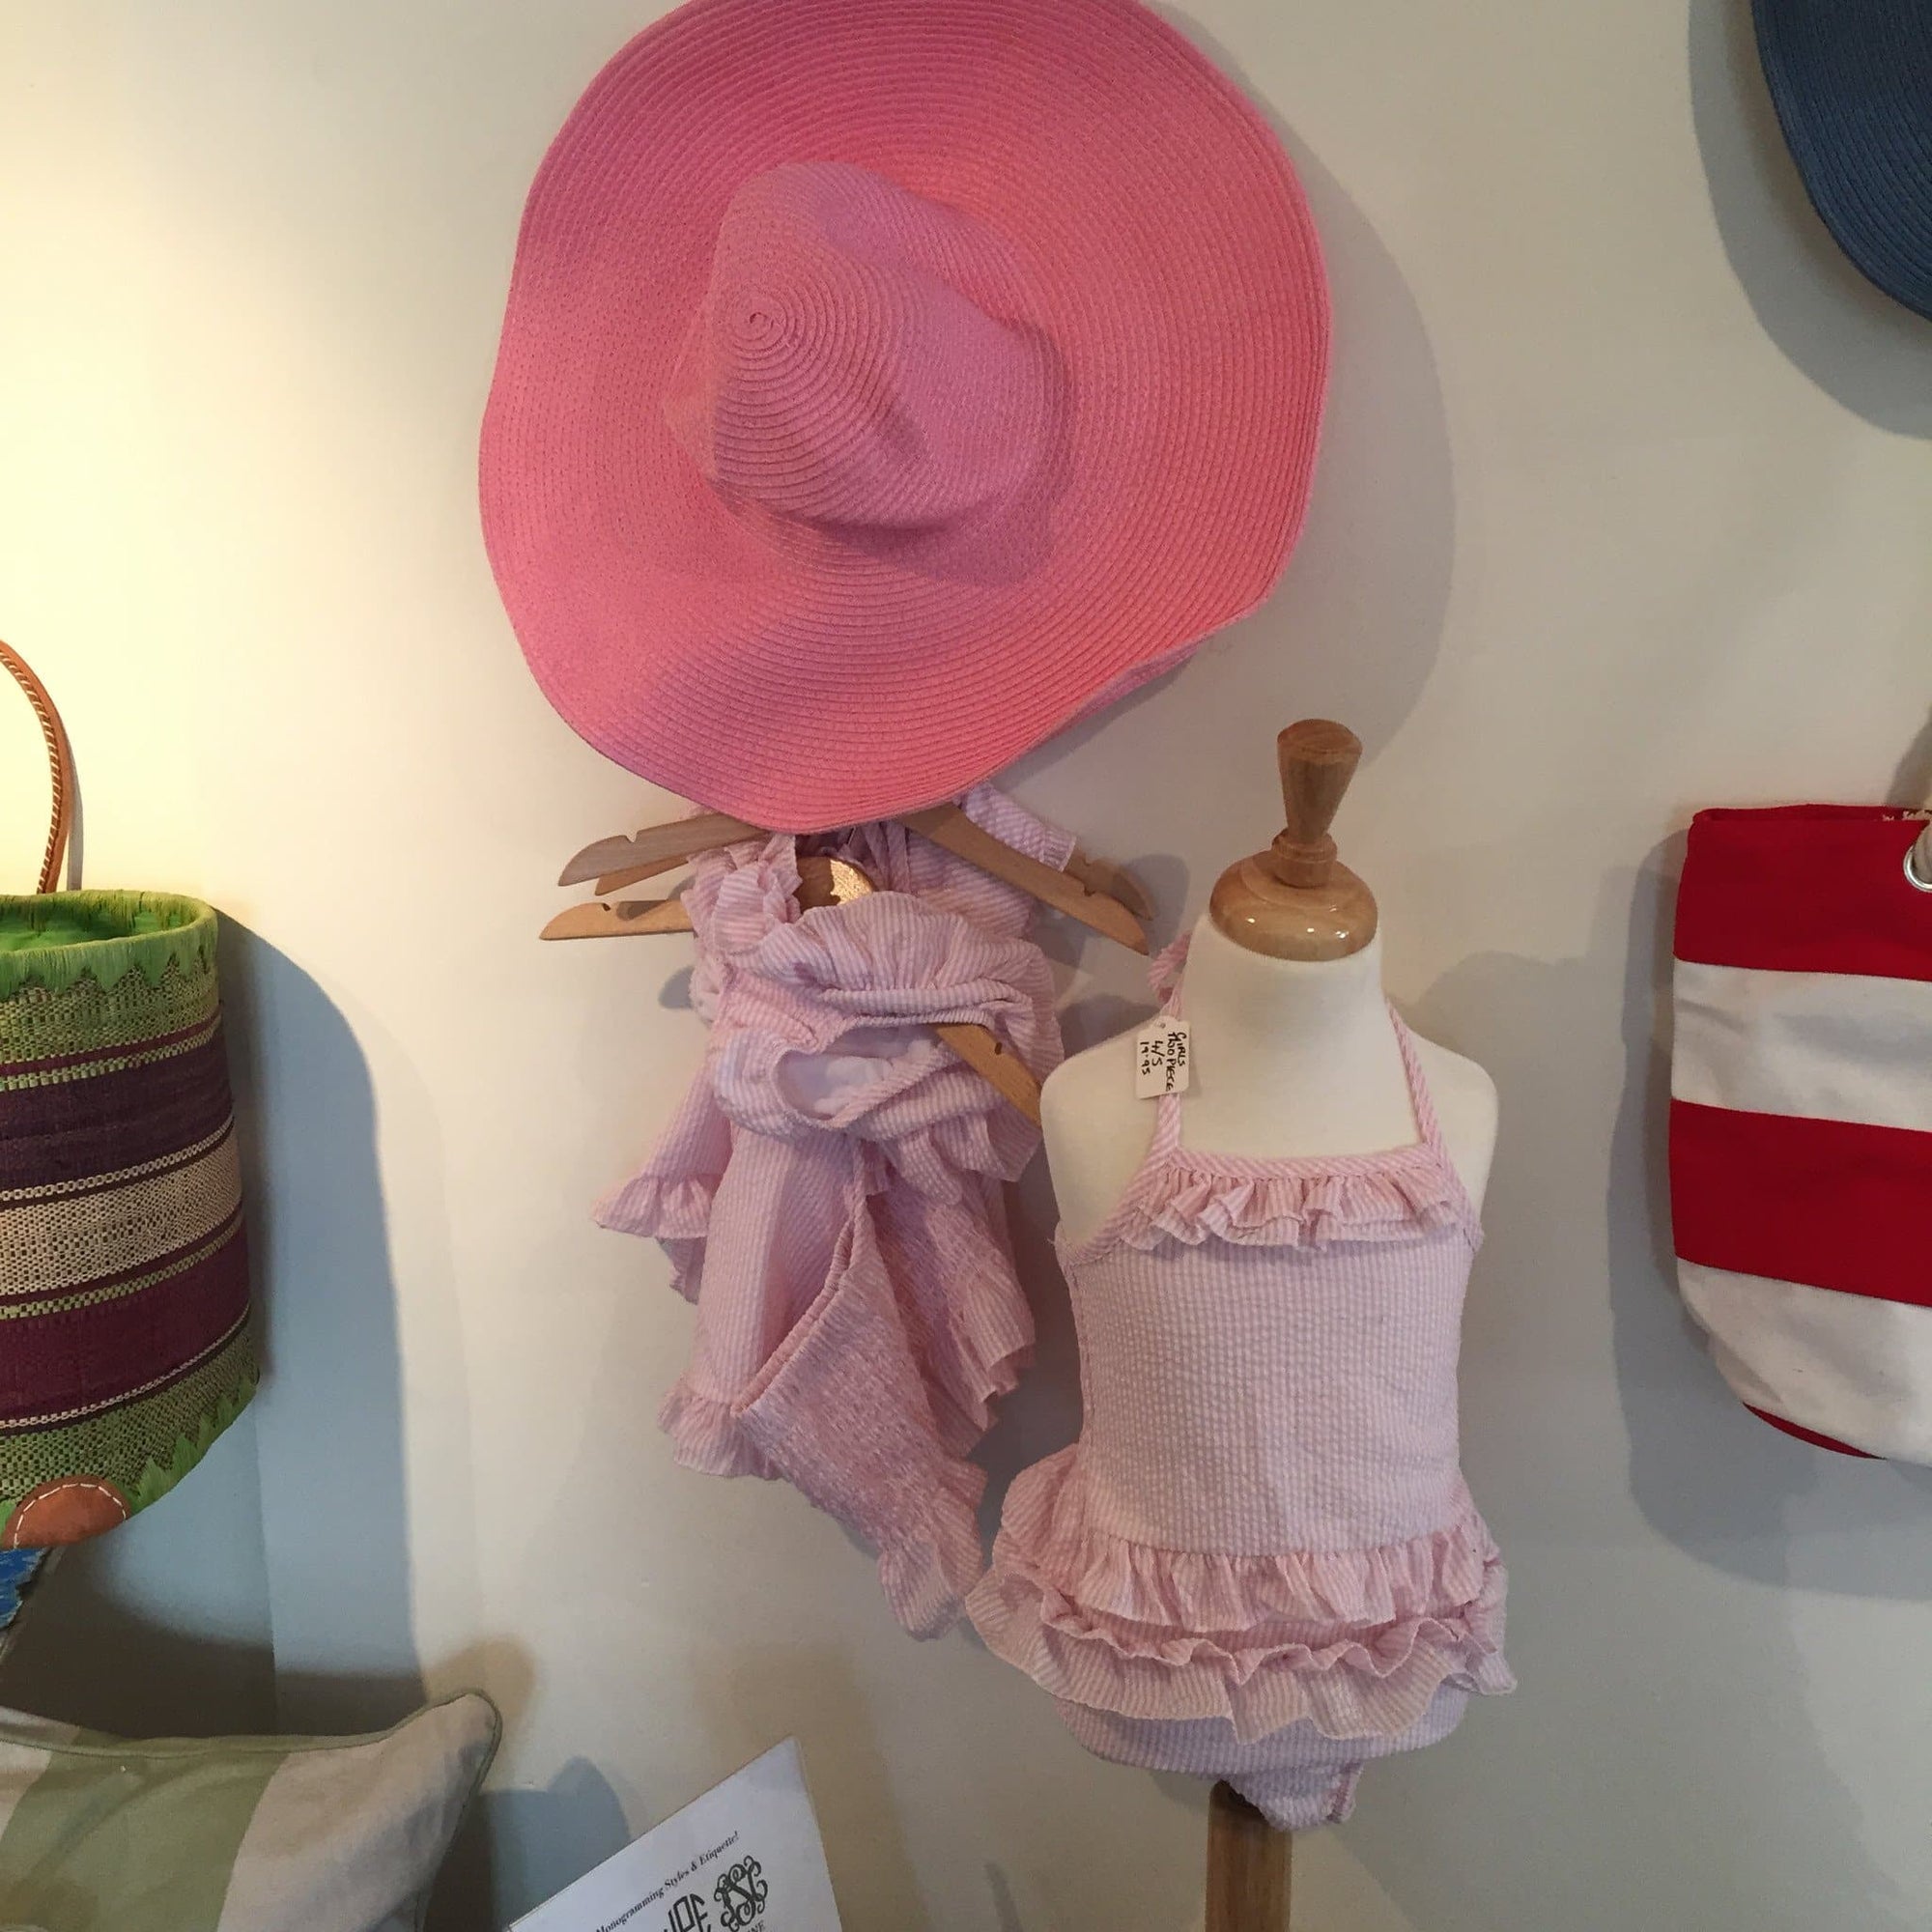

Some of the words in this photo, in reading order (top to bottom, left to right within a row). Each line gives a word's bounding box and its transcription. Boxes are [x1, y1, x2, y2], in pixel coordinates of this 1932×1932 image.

[1167, 1032, 1179, 1056] TWO
[1177, 1032, 1187, 1066] GIRLS
[1165, 1058, 1177, 1092] PIECE
[665, 1870, 690, 1890] Styles
[691, 1861, 697, 1872] &
